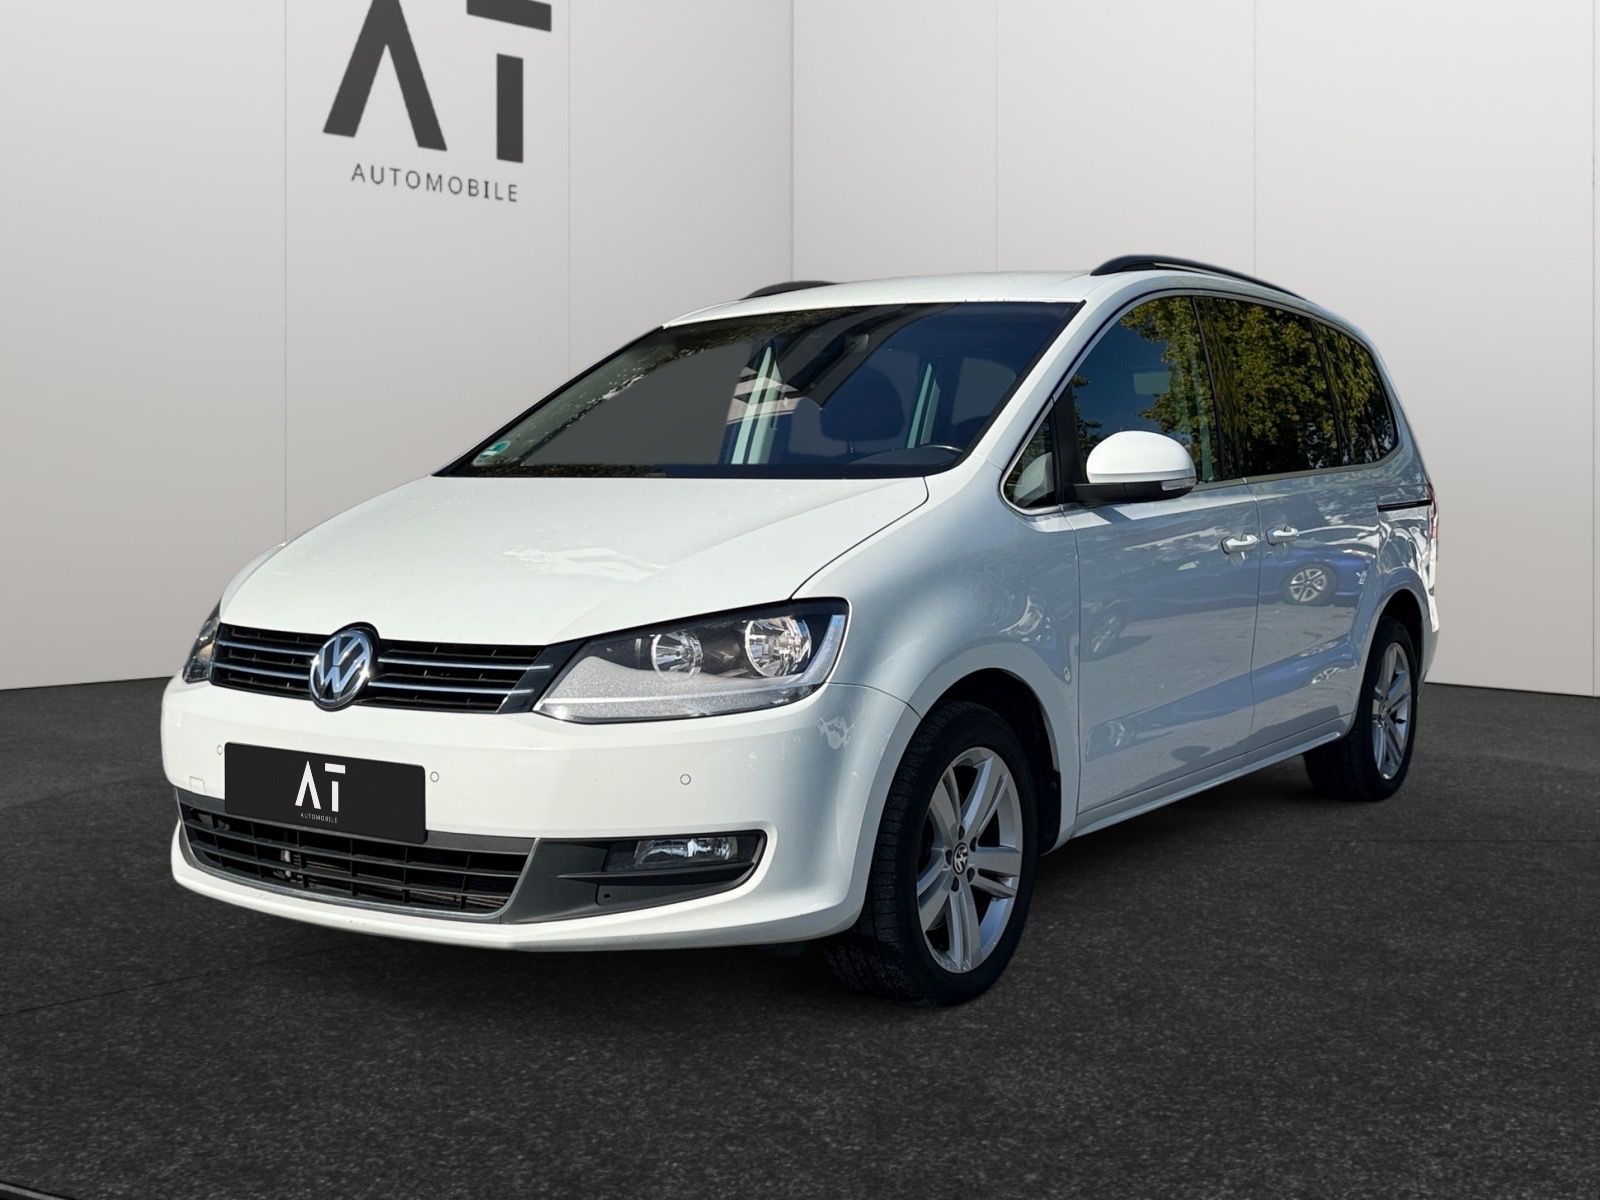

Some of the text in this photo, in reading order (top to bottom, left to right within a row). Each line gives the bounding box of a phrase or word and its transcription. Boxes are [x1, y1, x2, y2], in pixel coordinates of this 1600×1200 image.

[323, 0, 552, 163] AT
[351, 163, 518, 202] AUTOMOBILE
[310, 630, 371, 702] VW
[295, 760, 346, 812] AT
[300, 812, 339, 824] AUTOMOBILE
